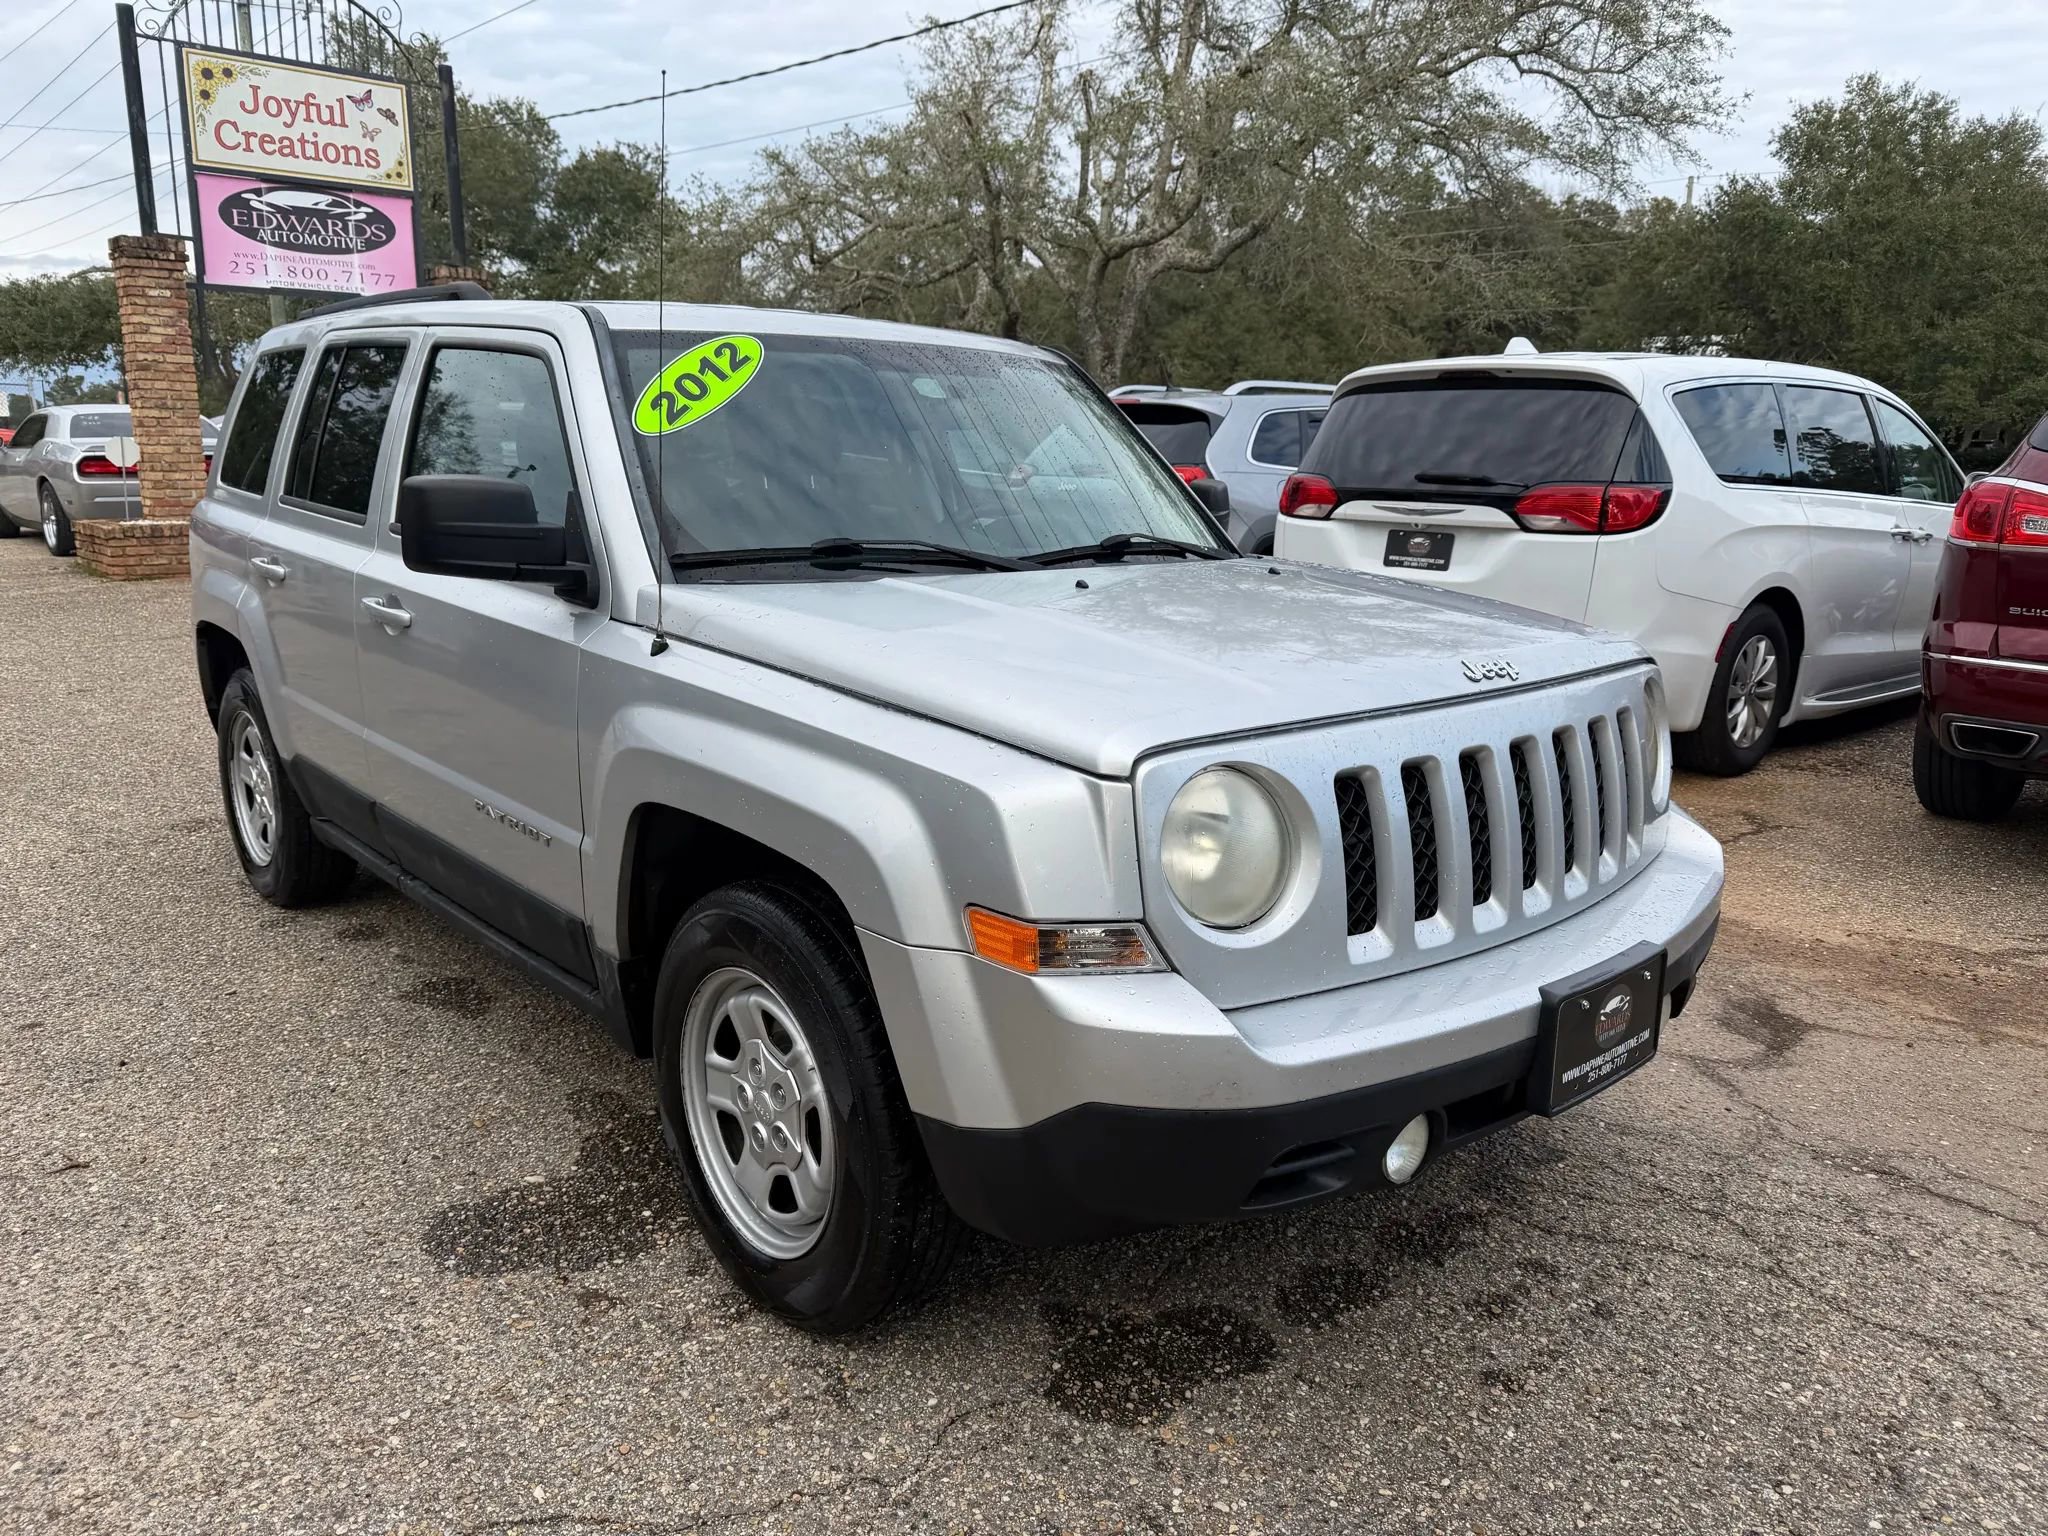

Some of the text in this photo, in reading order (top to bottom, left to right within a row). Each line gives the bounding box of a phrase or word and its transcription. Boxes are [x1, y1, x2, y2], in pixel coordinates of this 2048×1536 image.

[239, 84, 349, 128] Joyful
[213, 119, 381, 170] Creations
[231, 208, 387, 242] EDWARDS
[256, 228, 367, 250] AUTOMOTIVE
[228, 260, 396, 287] 251.800.7177
[233, 250, 376, 271] www.DAPHNEAUTOMOTIVEcom
[265, 279, 366, 293] MOTOR VEHICLE DEALER
[650, 342, 754, 426] 2012
[1461, 656, 1520, 682] Jeep
[474, 798, 552, 848] PATRIOT
[1562, 1027, 1650, 1084] WWW.DAPHNEAUTOMOTIVE.COM
[1587, 1053, 1628, 1083] 251-800-7177
